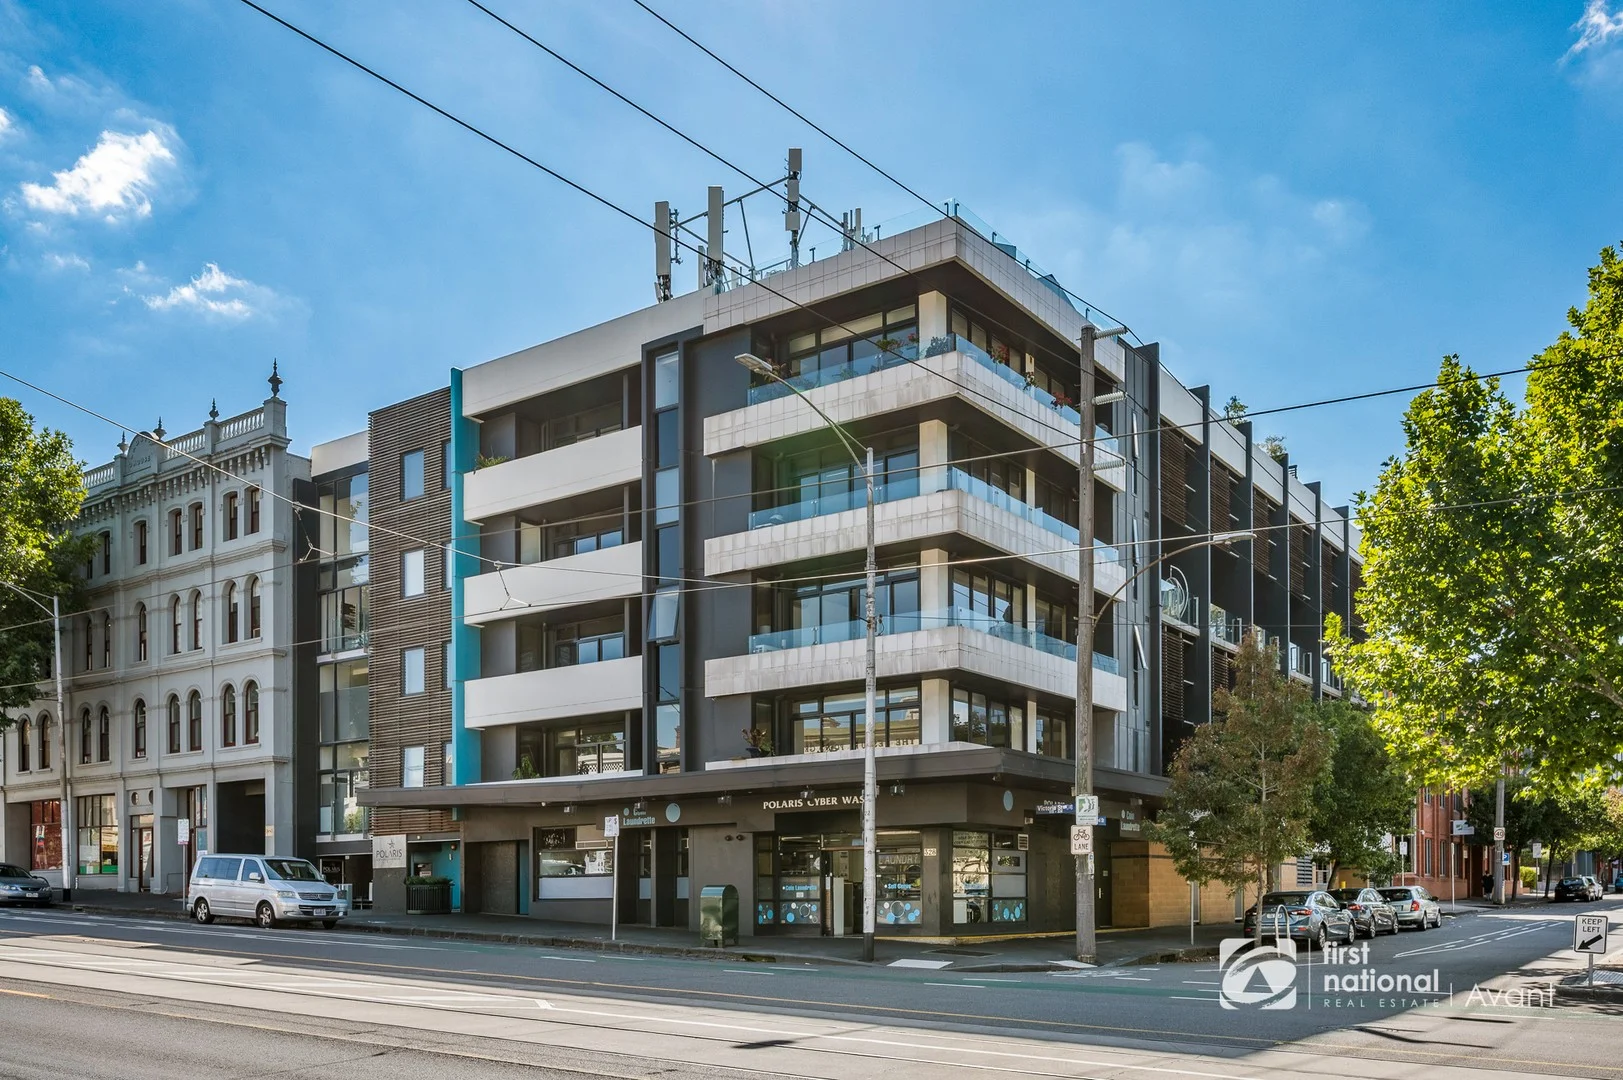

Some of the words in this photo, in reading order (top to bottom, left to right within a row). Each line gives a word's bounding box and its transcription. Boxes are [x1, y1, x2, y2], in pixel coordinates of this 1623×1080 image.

[763, 799, 803, 810] POLARIS
[841, 795, 865, 805] WAS
[623, 816, 655, 826] Laundrette
[1074, 843, 1089, 851] LANE
[376, 849, 403, 859] POLARIS
[878, 854, 918, 865] LAUNDRY
[1581, 917, 1603, 926] KEEP
[1582, 925, 1601, 933] LEFT
